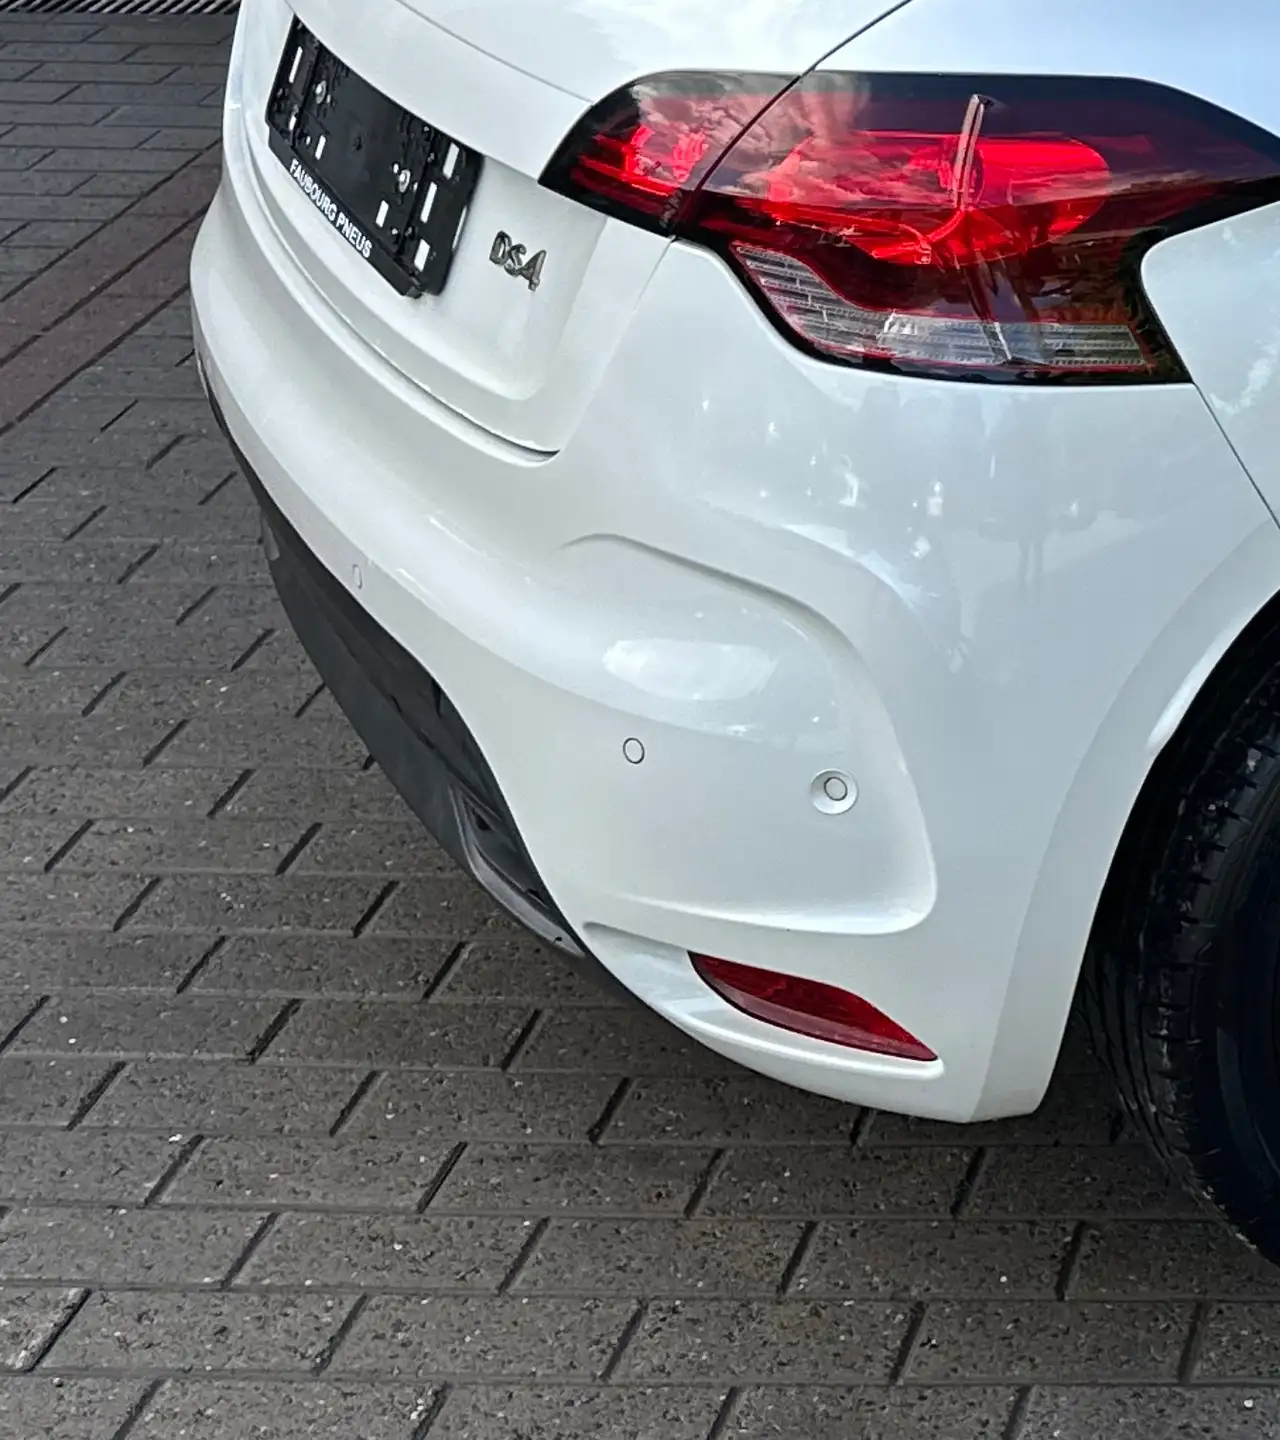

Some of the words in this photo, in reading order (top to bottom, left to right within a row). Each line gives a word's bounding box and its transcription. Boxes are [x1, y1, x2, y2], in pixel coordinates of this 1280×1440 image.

[289, 159, 338, 221] FAUBOURG
[335, 211, 372, 258] PNEUS
[488, 230, 547, 292] DS4
